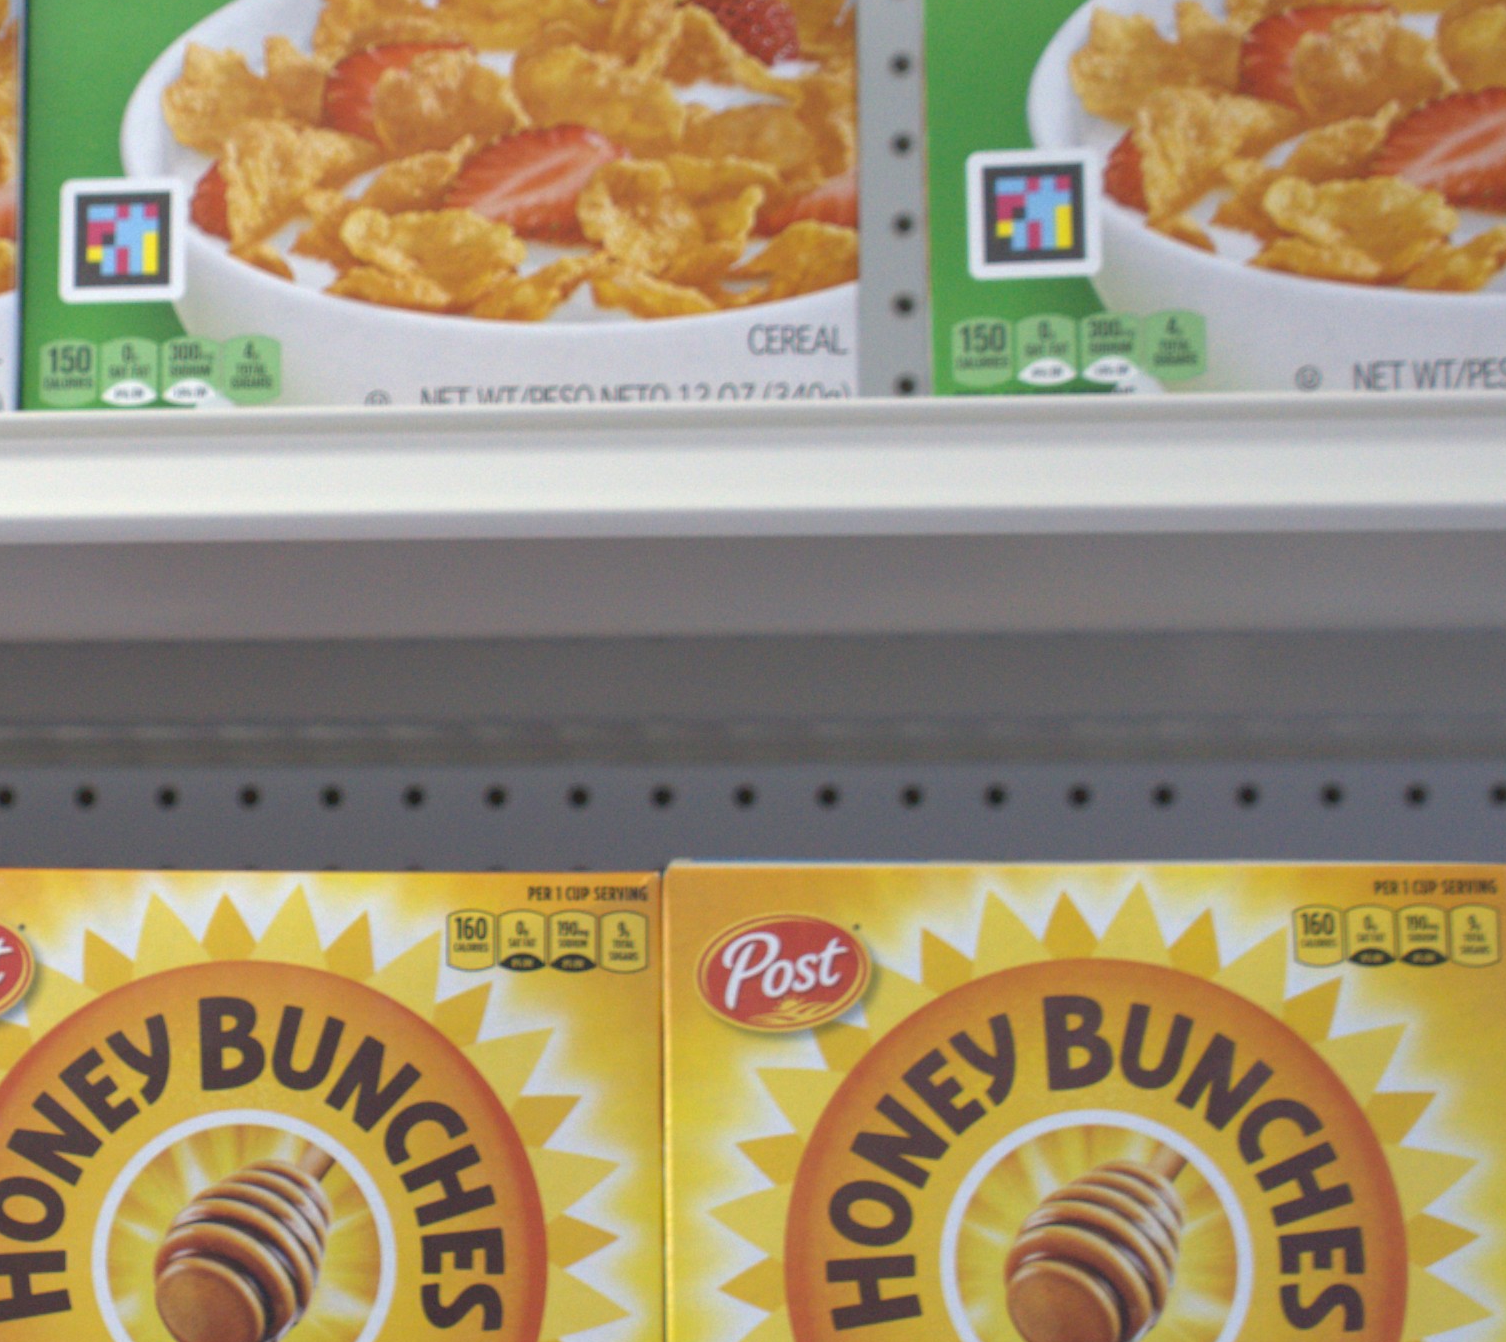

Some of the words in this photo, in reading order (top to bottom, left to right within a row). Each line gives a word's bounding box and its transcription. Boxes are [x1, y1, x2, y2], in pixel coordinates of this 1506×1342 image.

[454, 916, 488, 941] 160
[527, 886, 552, 901] PER
[565, 886, 590, 901] CUP
[594, 885, 648, 902] SERVING
[723, 930, 843, 1012] Post
[198, 996, 506, 1332] BUNCHES
[826, 1013, 1017, 1332] HONEY
[1043, 994, 1366, 1335] BUNCHES
